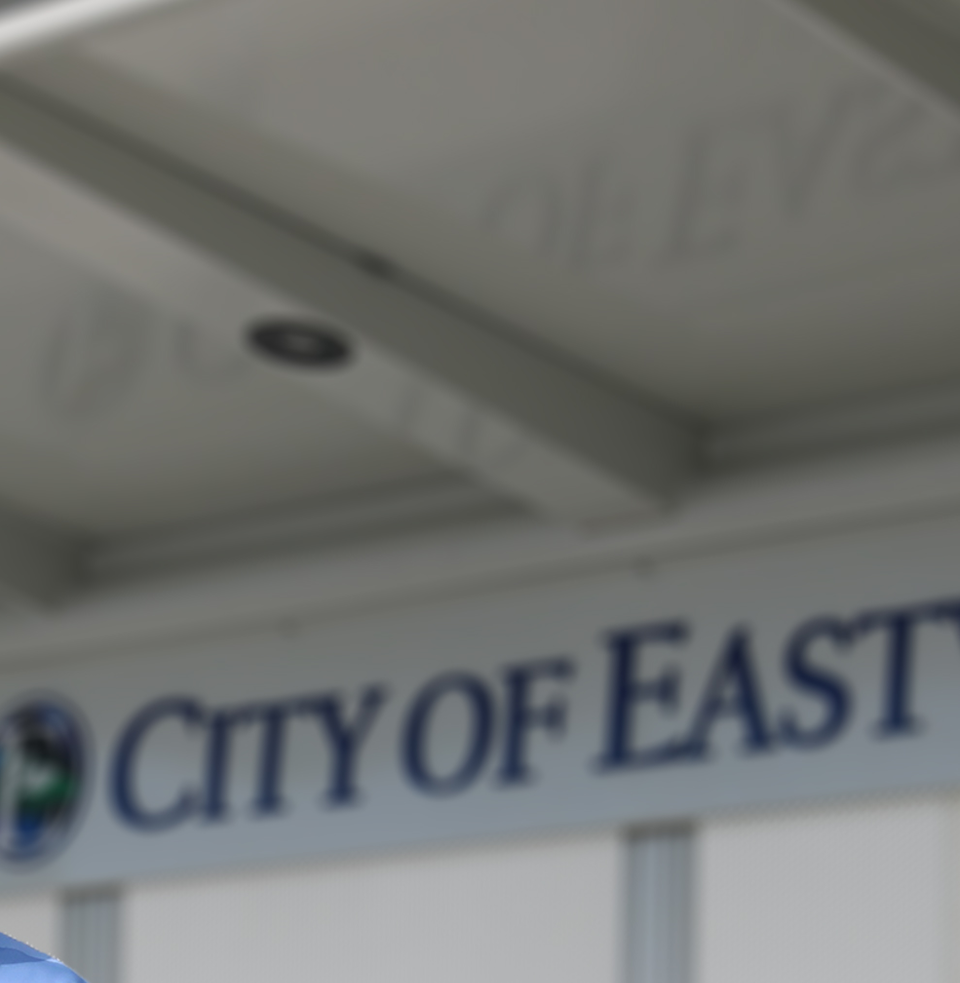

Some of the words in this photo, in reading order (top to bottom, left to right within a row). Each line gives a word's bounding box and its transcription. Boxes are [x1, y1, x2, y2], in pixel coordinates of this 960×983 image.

[106, 681, 388, 836] CITY
[400, 656, 574, 798] OF
[592, 596, 960, 774] EAST
